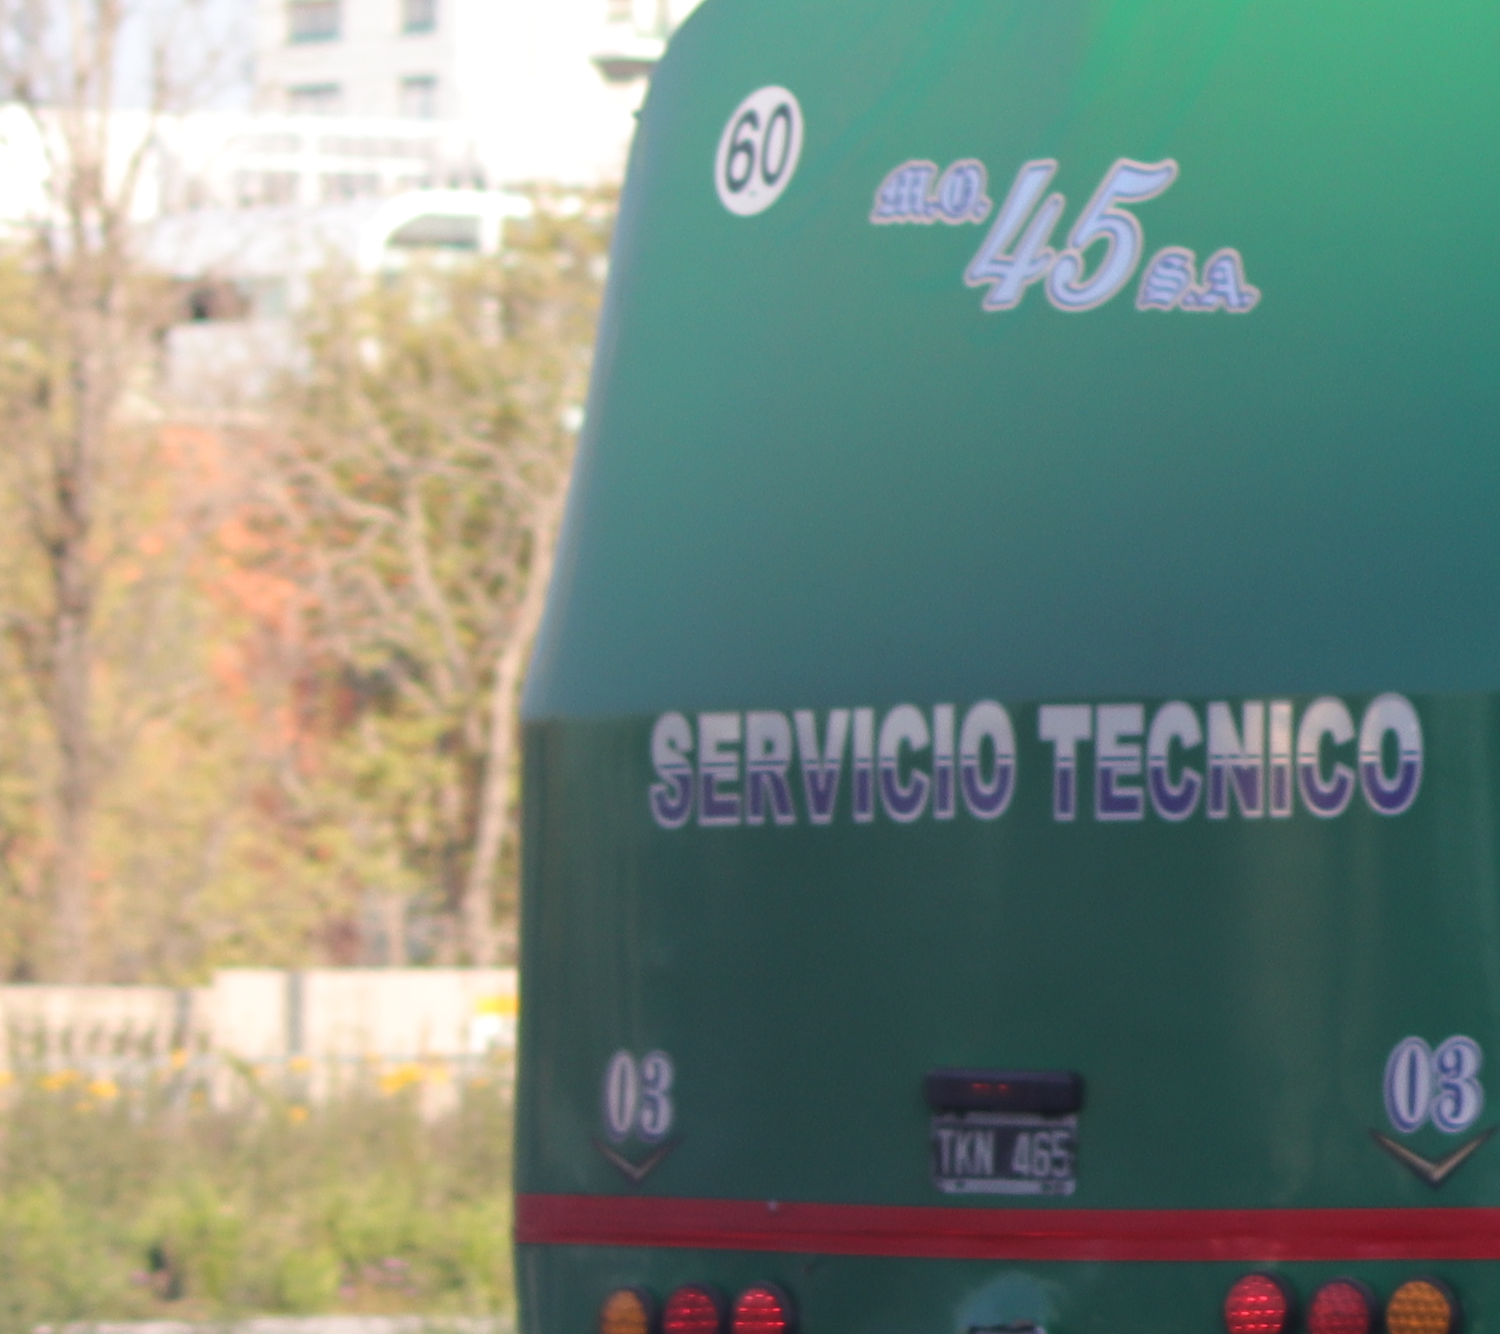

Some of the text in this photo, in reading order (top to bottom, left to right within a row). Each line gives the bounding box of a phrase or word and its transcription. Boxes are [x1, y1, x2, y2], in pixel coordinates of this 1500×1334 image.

[725, 103, 794, 194] 60
[963, 157, 1179, 312] 45
[649, 692, 1424, 828] SERVICIO TECNICO
[605, 1050, 676, 1142] 03
[1383, 1034, 1483, 1134] 03
[1011, 1130, 1072, 1178] 465
